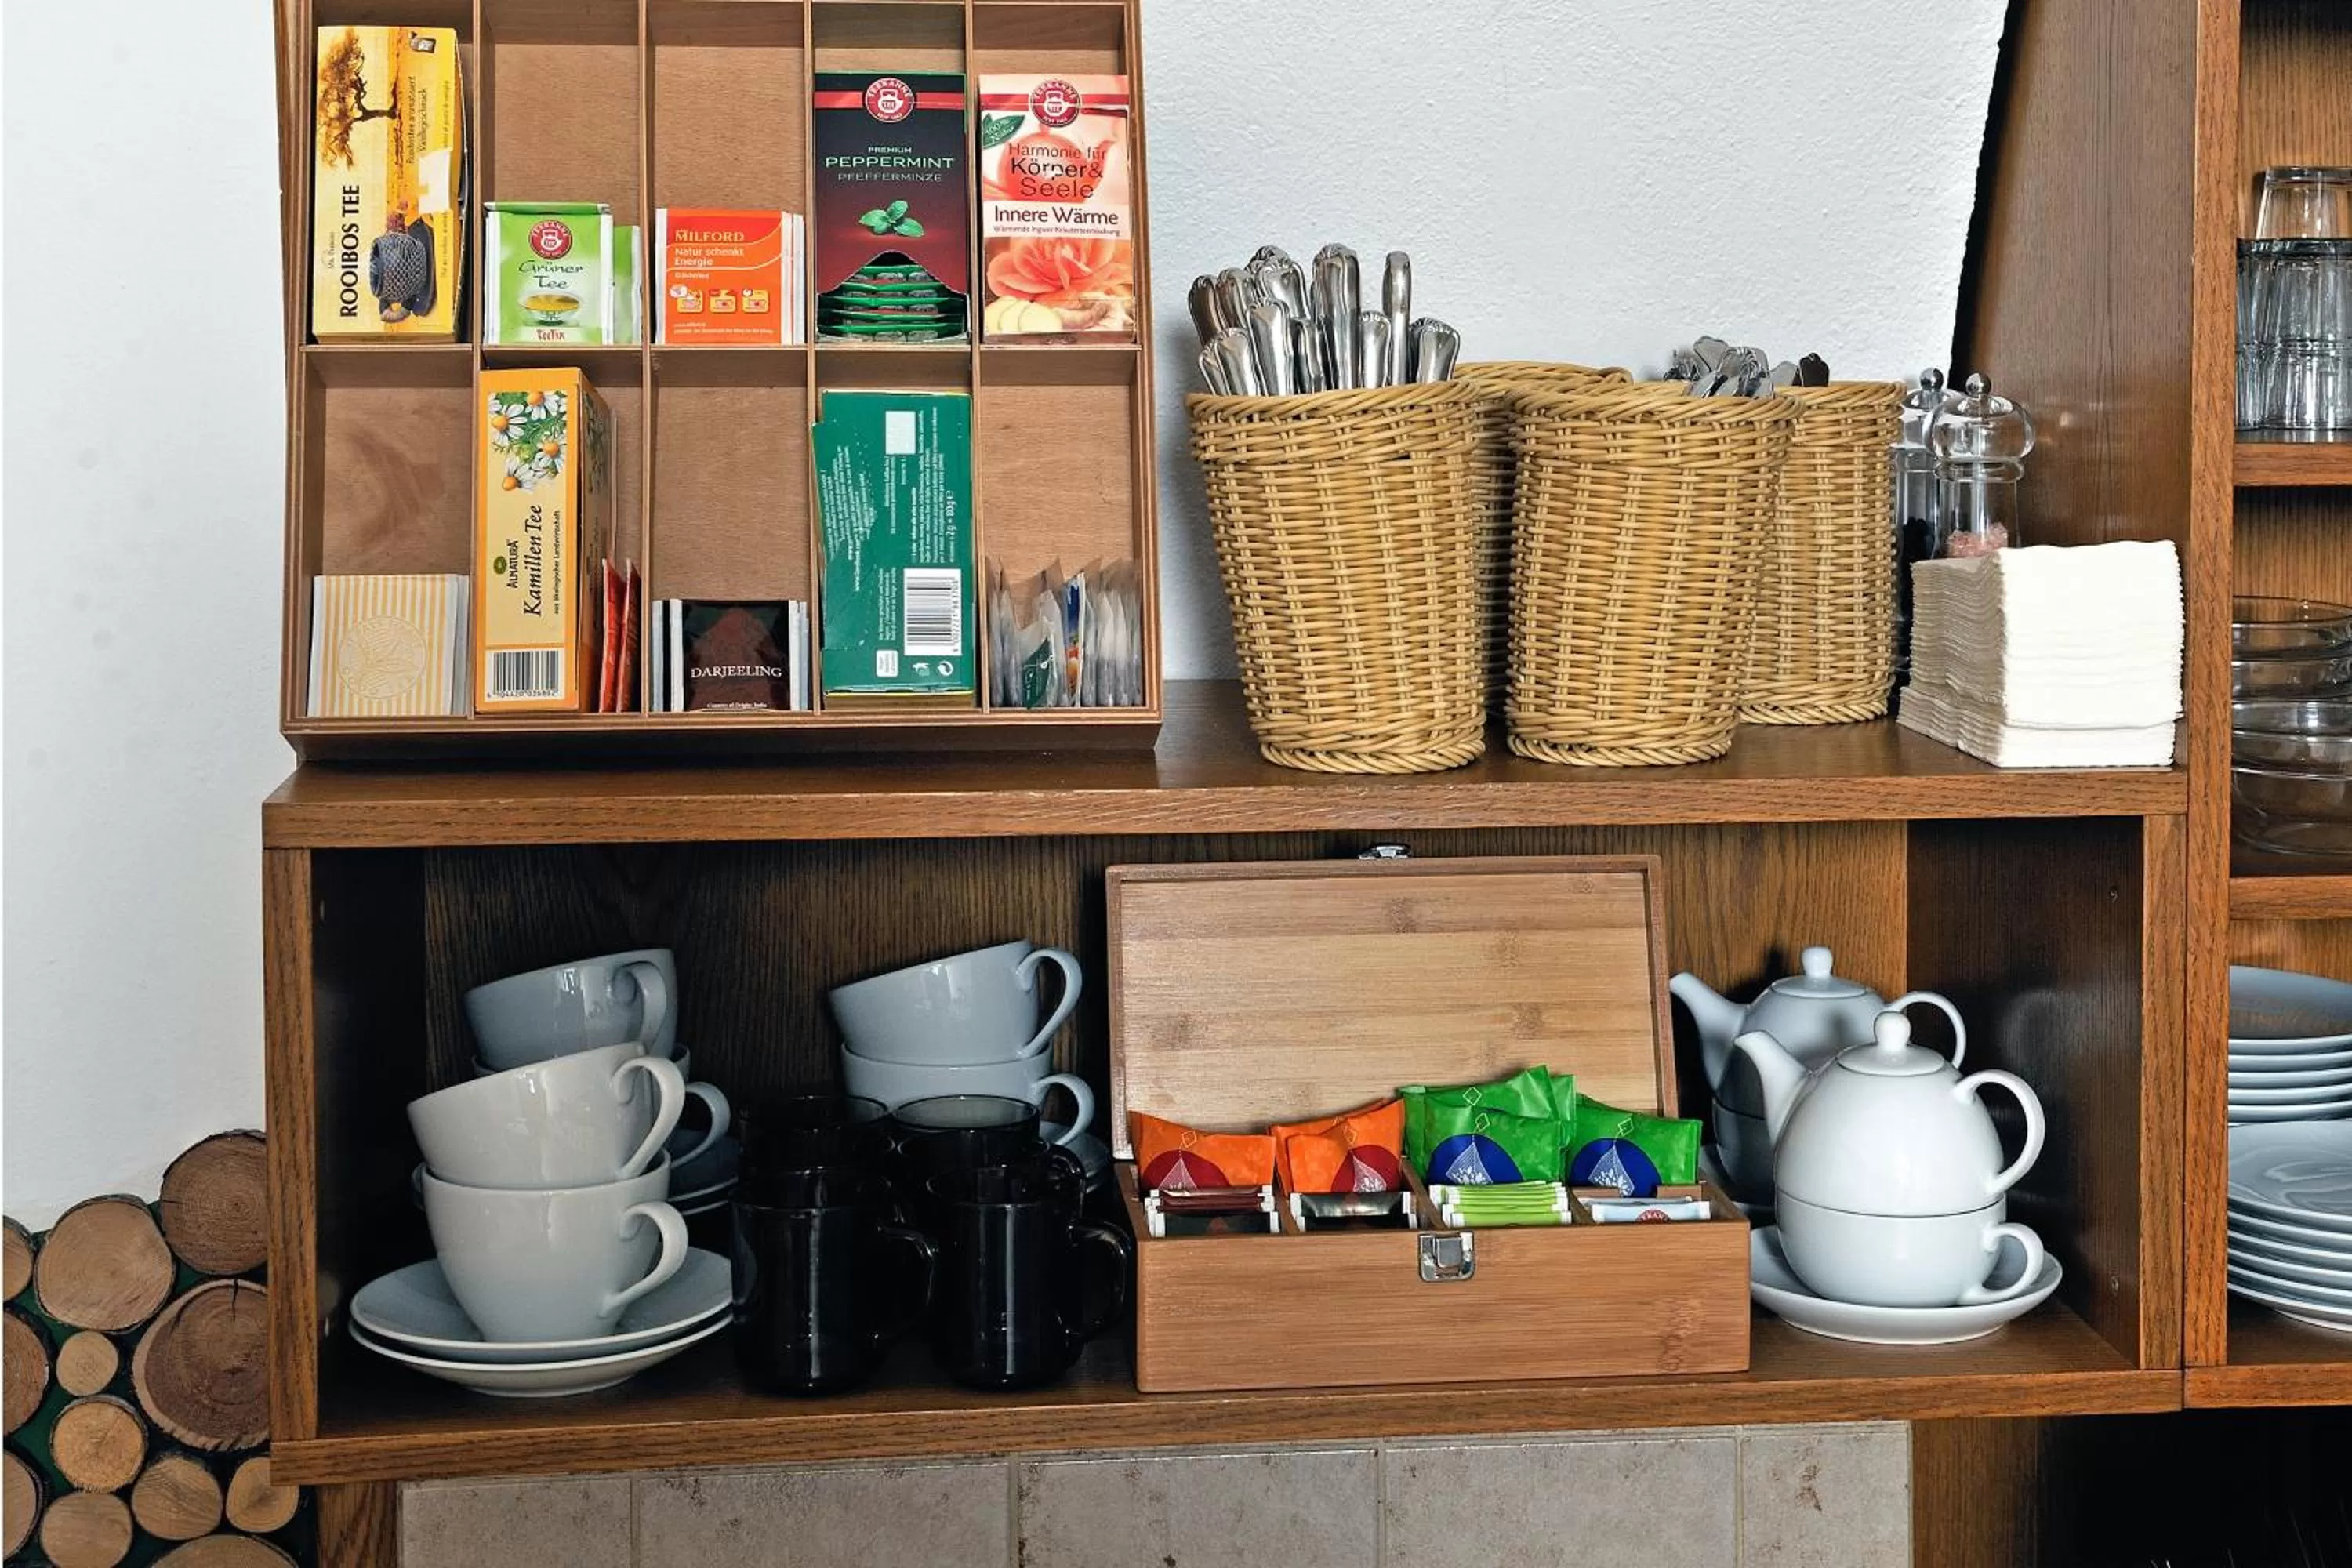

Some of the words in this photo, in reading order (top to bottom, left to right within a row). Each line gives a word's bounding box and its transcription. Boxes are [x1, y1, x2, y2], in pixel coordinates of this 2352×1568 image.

[1008, 143, 1081, 158] Harmonie
[1087, 146, 1107, 159] für
[826, 156, 954, 169] PEPPERMINT
[838, 172, 942, 182] PFEFFERMINZE
[1021, 176, 1094, 198] Seele
[342, 185, 360, 218] TEE
[994, 205, 1049, 223] Innere
[1051, 206, 1120, 225] Wärme
[675, 230, 744, 242] MILFORD
[674, 246, 703, 257] Natur
[705, 246, 744, 257] schenkt
[518, 260, 584, 274] Grüner
[674, 256, 714, 268] Energie
[339, 223, 359, 318] ROOIBOS
[533, 275, 568, 289] Tee
[524, 505, 543, 534] Tee
[506, 540, 519, 589] ALNATURA
[523, 535, 543, 617] Kamillen
[691, 666, 782, 678] DARJEELING
